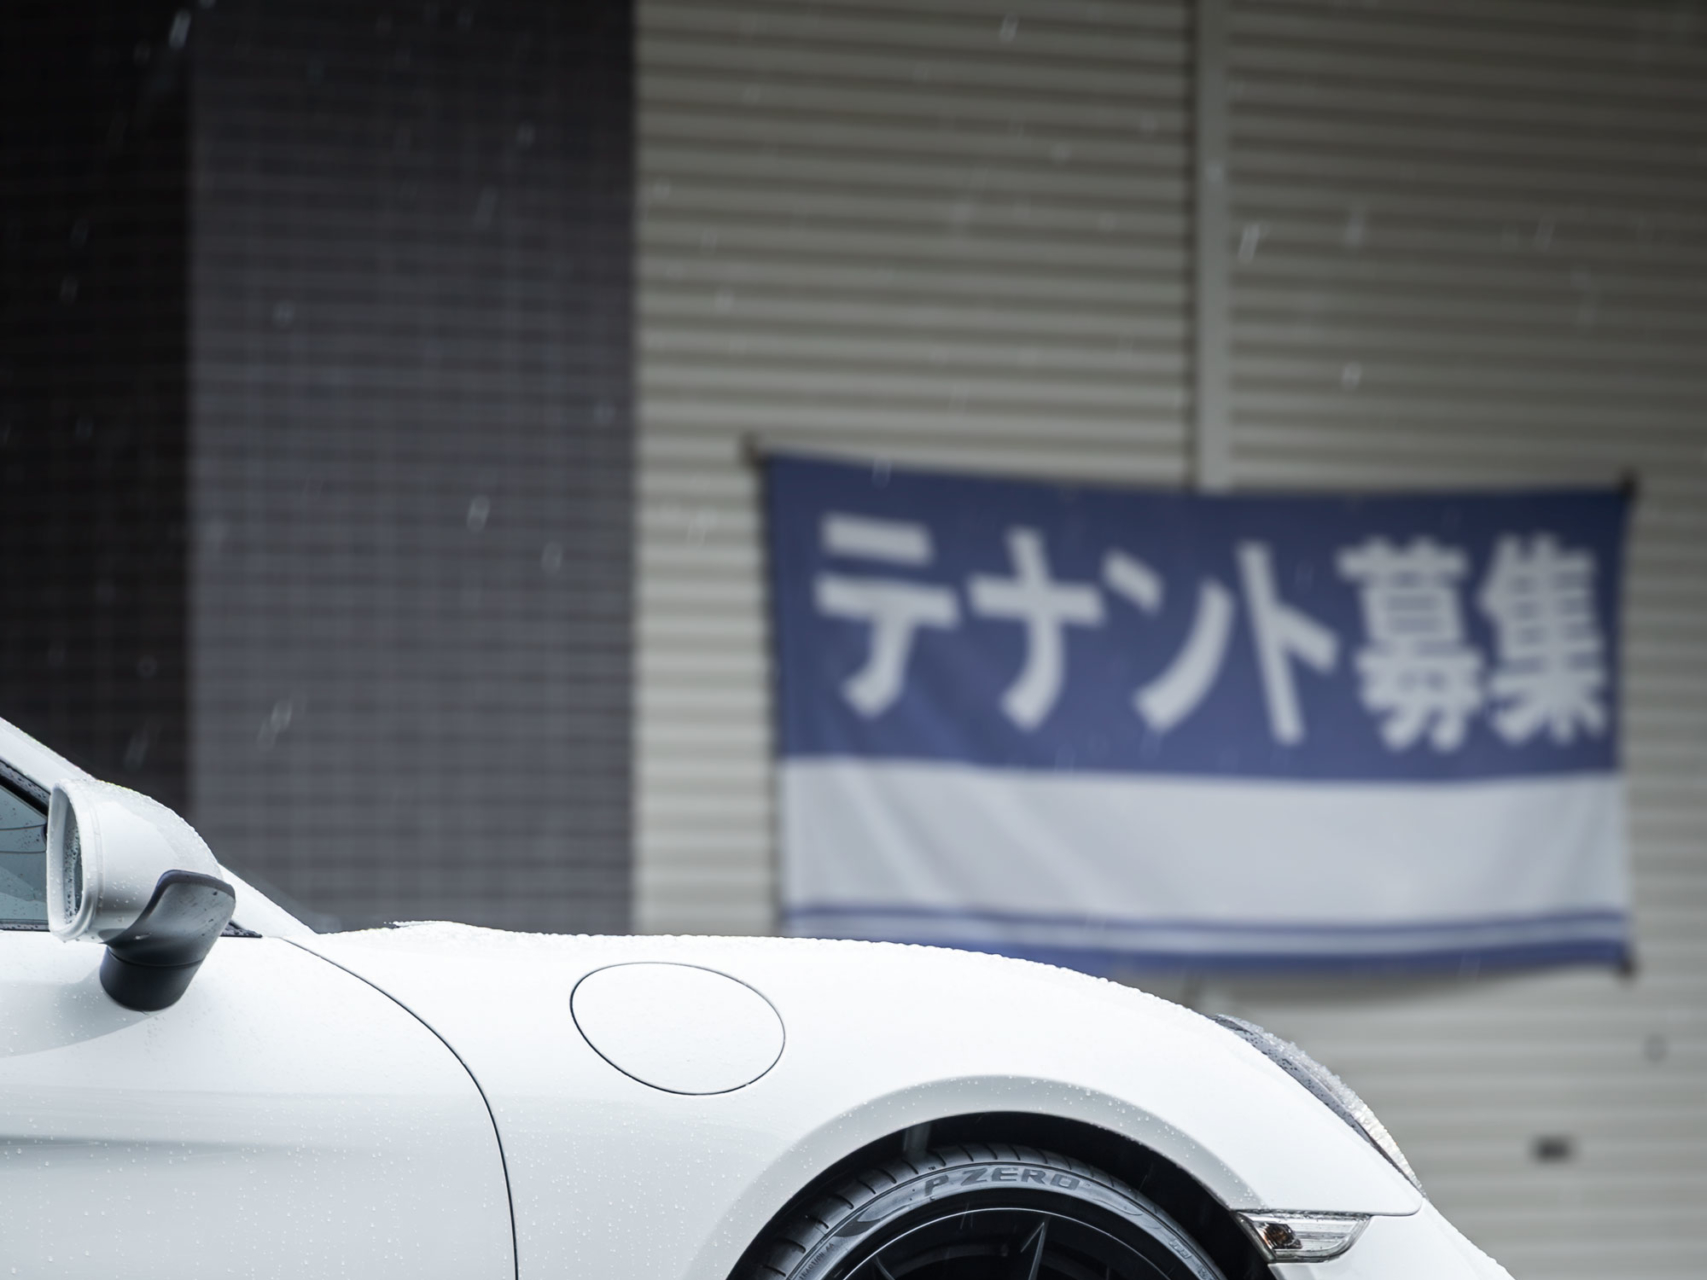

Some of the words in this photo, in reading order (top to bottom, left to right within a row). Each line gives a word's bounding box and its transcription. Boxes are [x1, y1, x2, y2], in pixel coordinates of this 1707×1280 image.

[812, 512, 1608, 751] テナント募集
[924, 1175, 949, 1196] P
[961, 1167, 1080, 1190] ZERO
